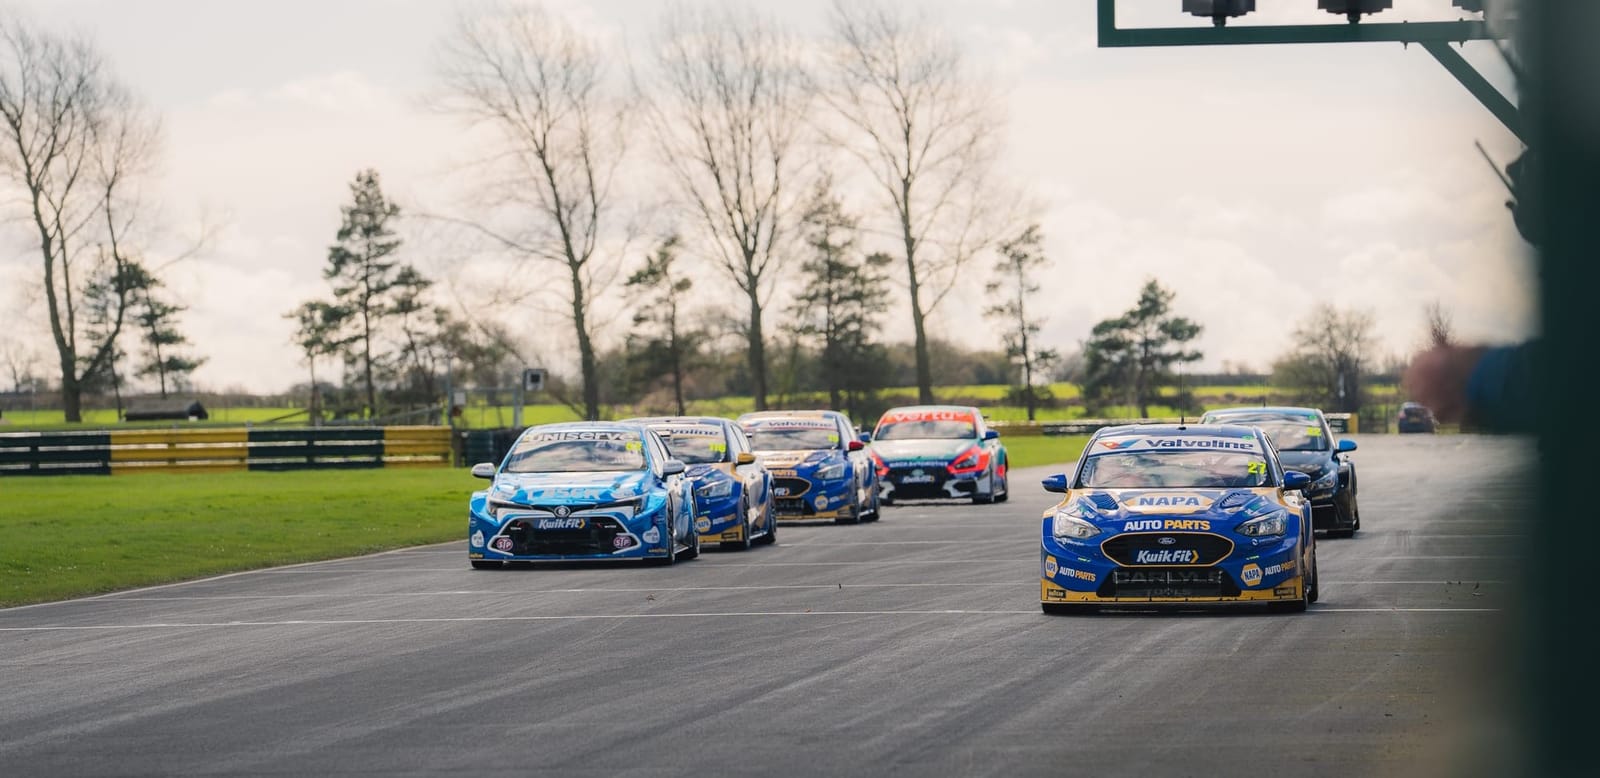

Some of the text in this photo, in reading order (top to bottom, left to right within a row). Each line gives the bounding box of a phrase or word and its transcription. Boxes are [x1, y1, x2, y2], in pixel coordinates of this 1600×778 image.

[1146, 438, 1254, 450] Valvoline
[1247, 461, 1267, 475] 27
[1139, 496, 1201, 506] NAPA
[1123, 519, 1211, 531] AUTO PARTS
[498, 539, 512, 549] STP
[615, 537, 630, 547] STP
[1059, 566, 1097, 582] AUTO PARTS
[1244, 567, 1260, 580] NAPA
[1264, 564, 1281, 576] AUTO
